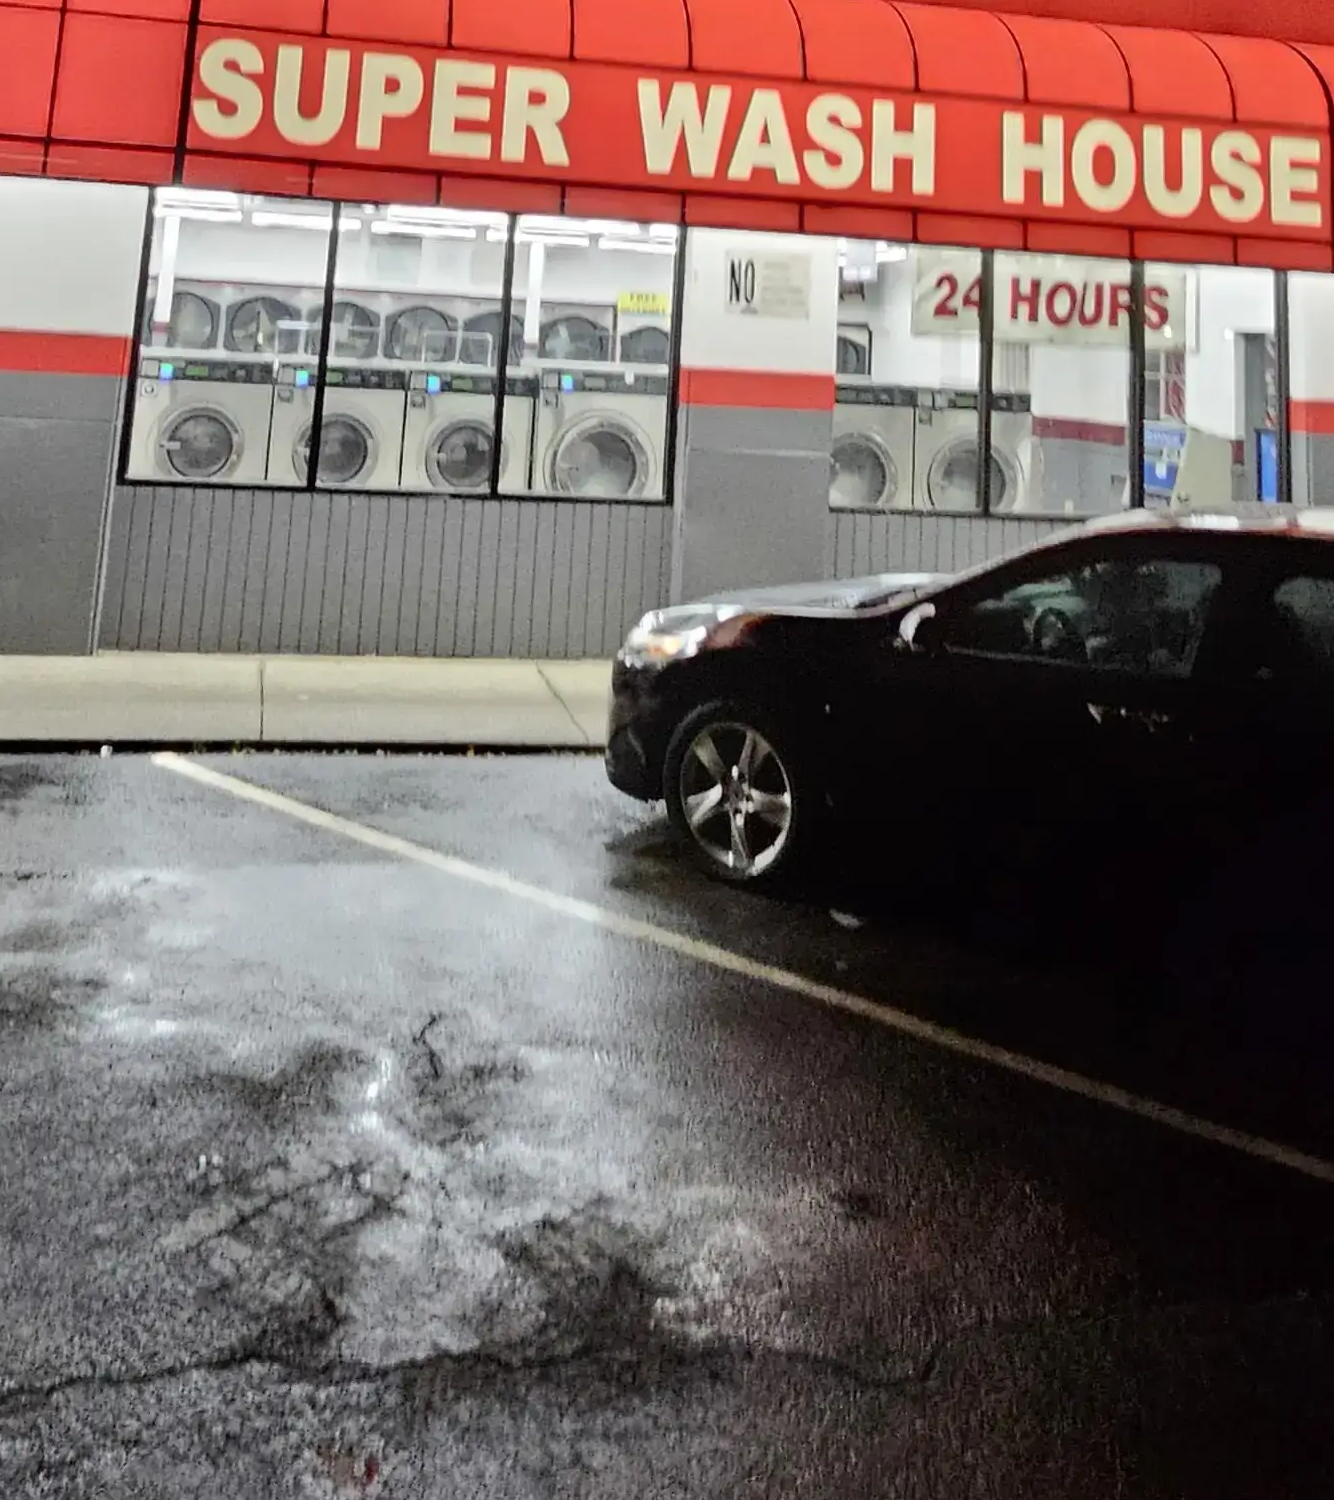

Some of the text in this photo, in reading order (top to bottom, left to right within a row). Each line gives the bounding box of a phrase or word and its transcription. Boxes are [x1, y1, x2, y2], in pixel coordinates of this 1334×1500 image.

[192, 37, 1323, 228] SUPER WASH HOUSE
[729, 258, 755, 304] NO
[1010, 275, 1169, 330] HOURS
